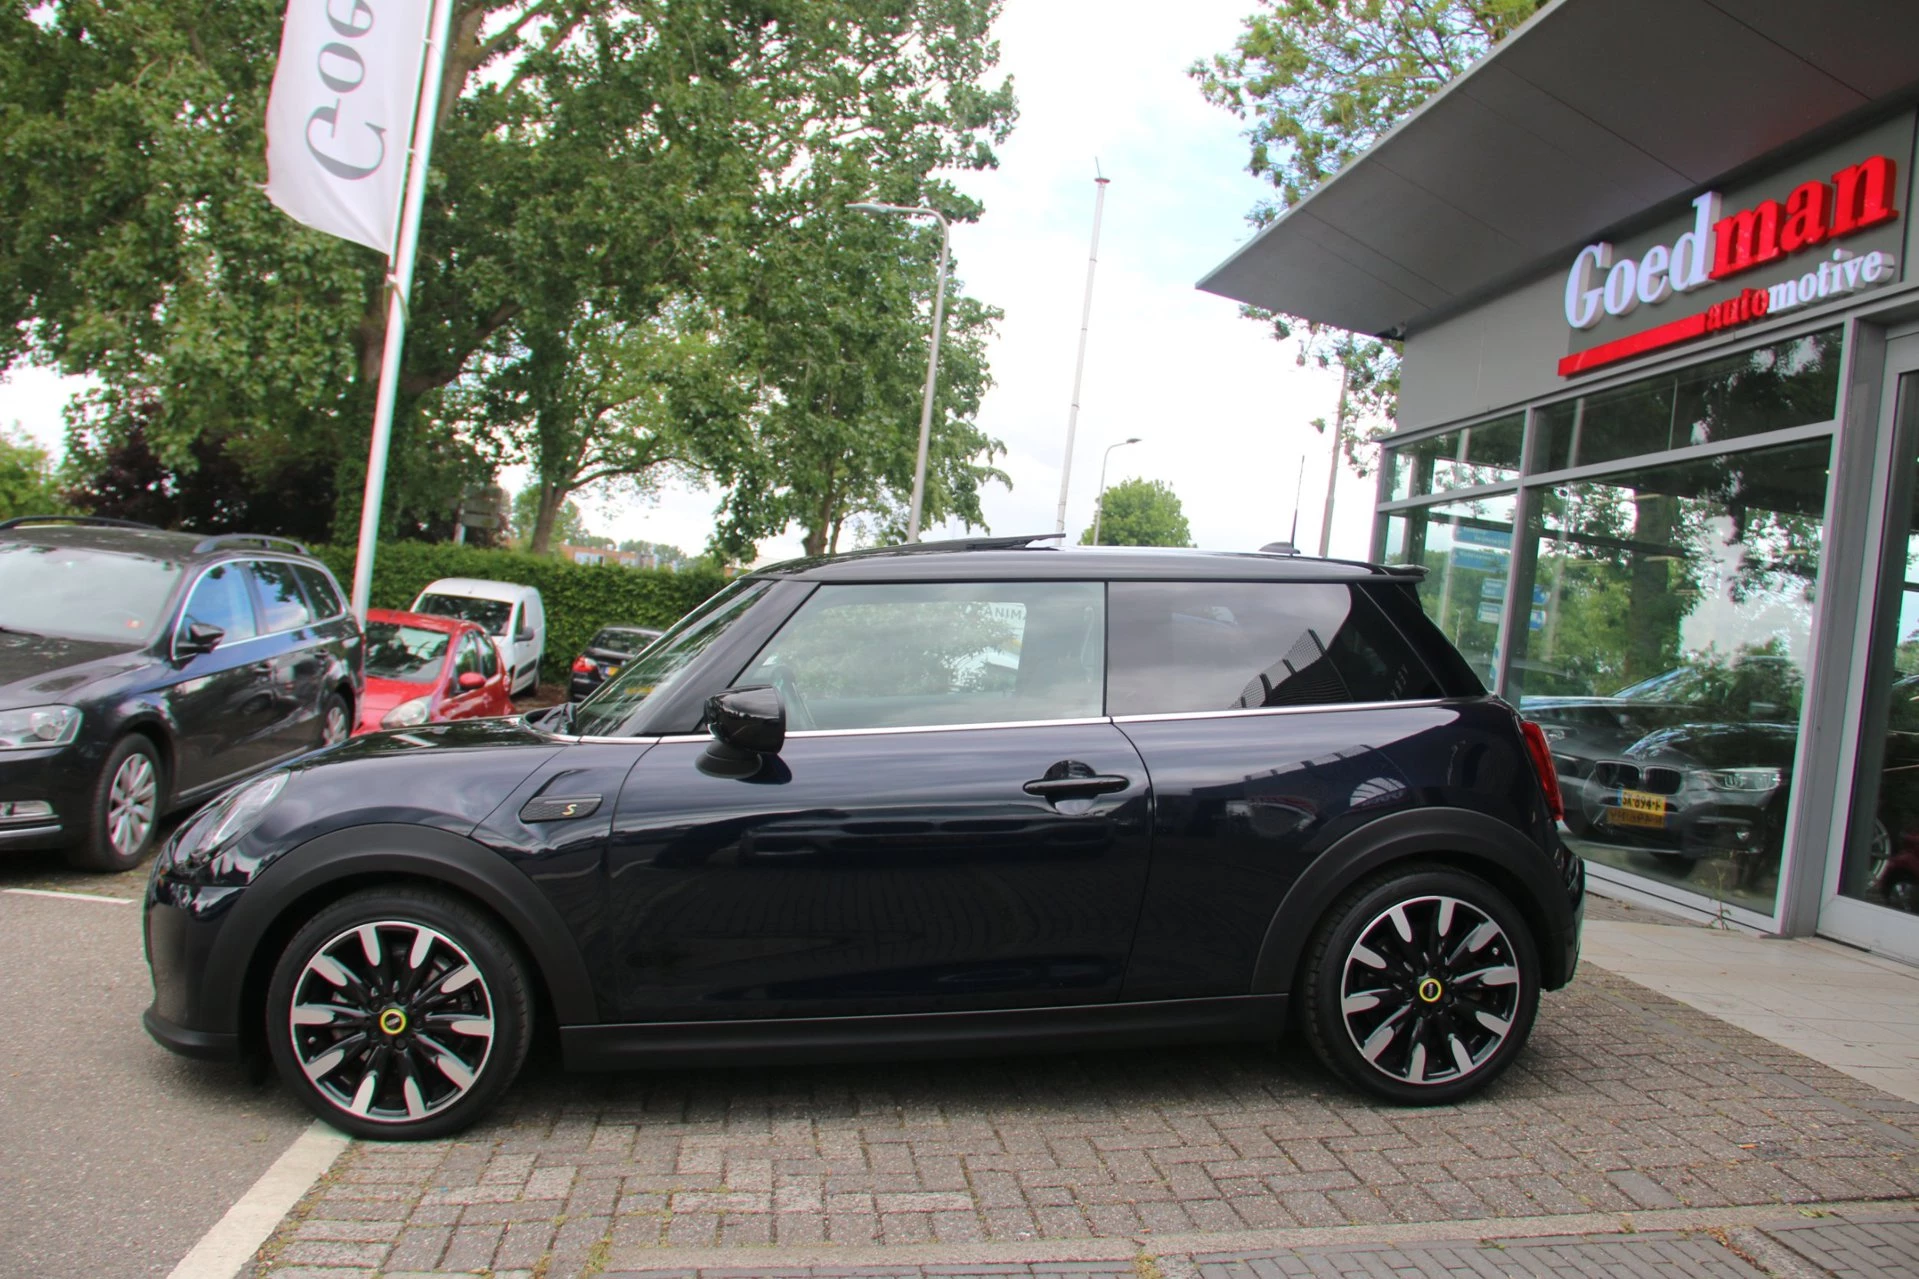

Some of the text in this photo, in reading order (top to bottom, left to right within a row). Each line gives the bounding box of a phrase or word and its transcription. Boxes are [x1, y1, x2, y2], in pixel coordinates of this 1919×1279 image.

[1564, 155, 1899, 329] Goedman
[1706, 248, 1896, 331] automotive
[983, 606, 1027, 620] ANIM
[562, 804, 577, 816] S
